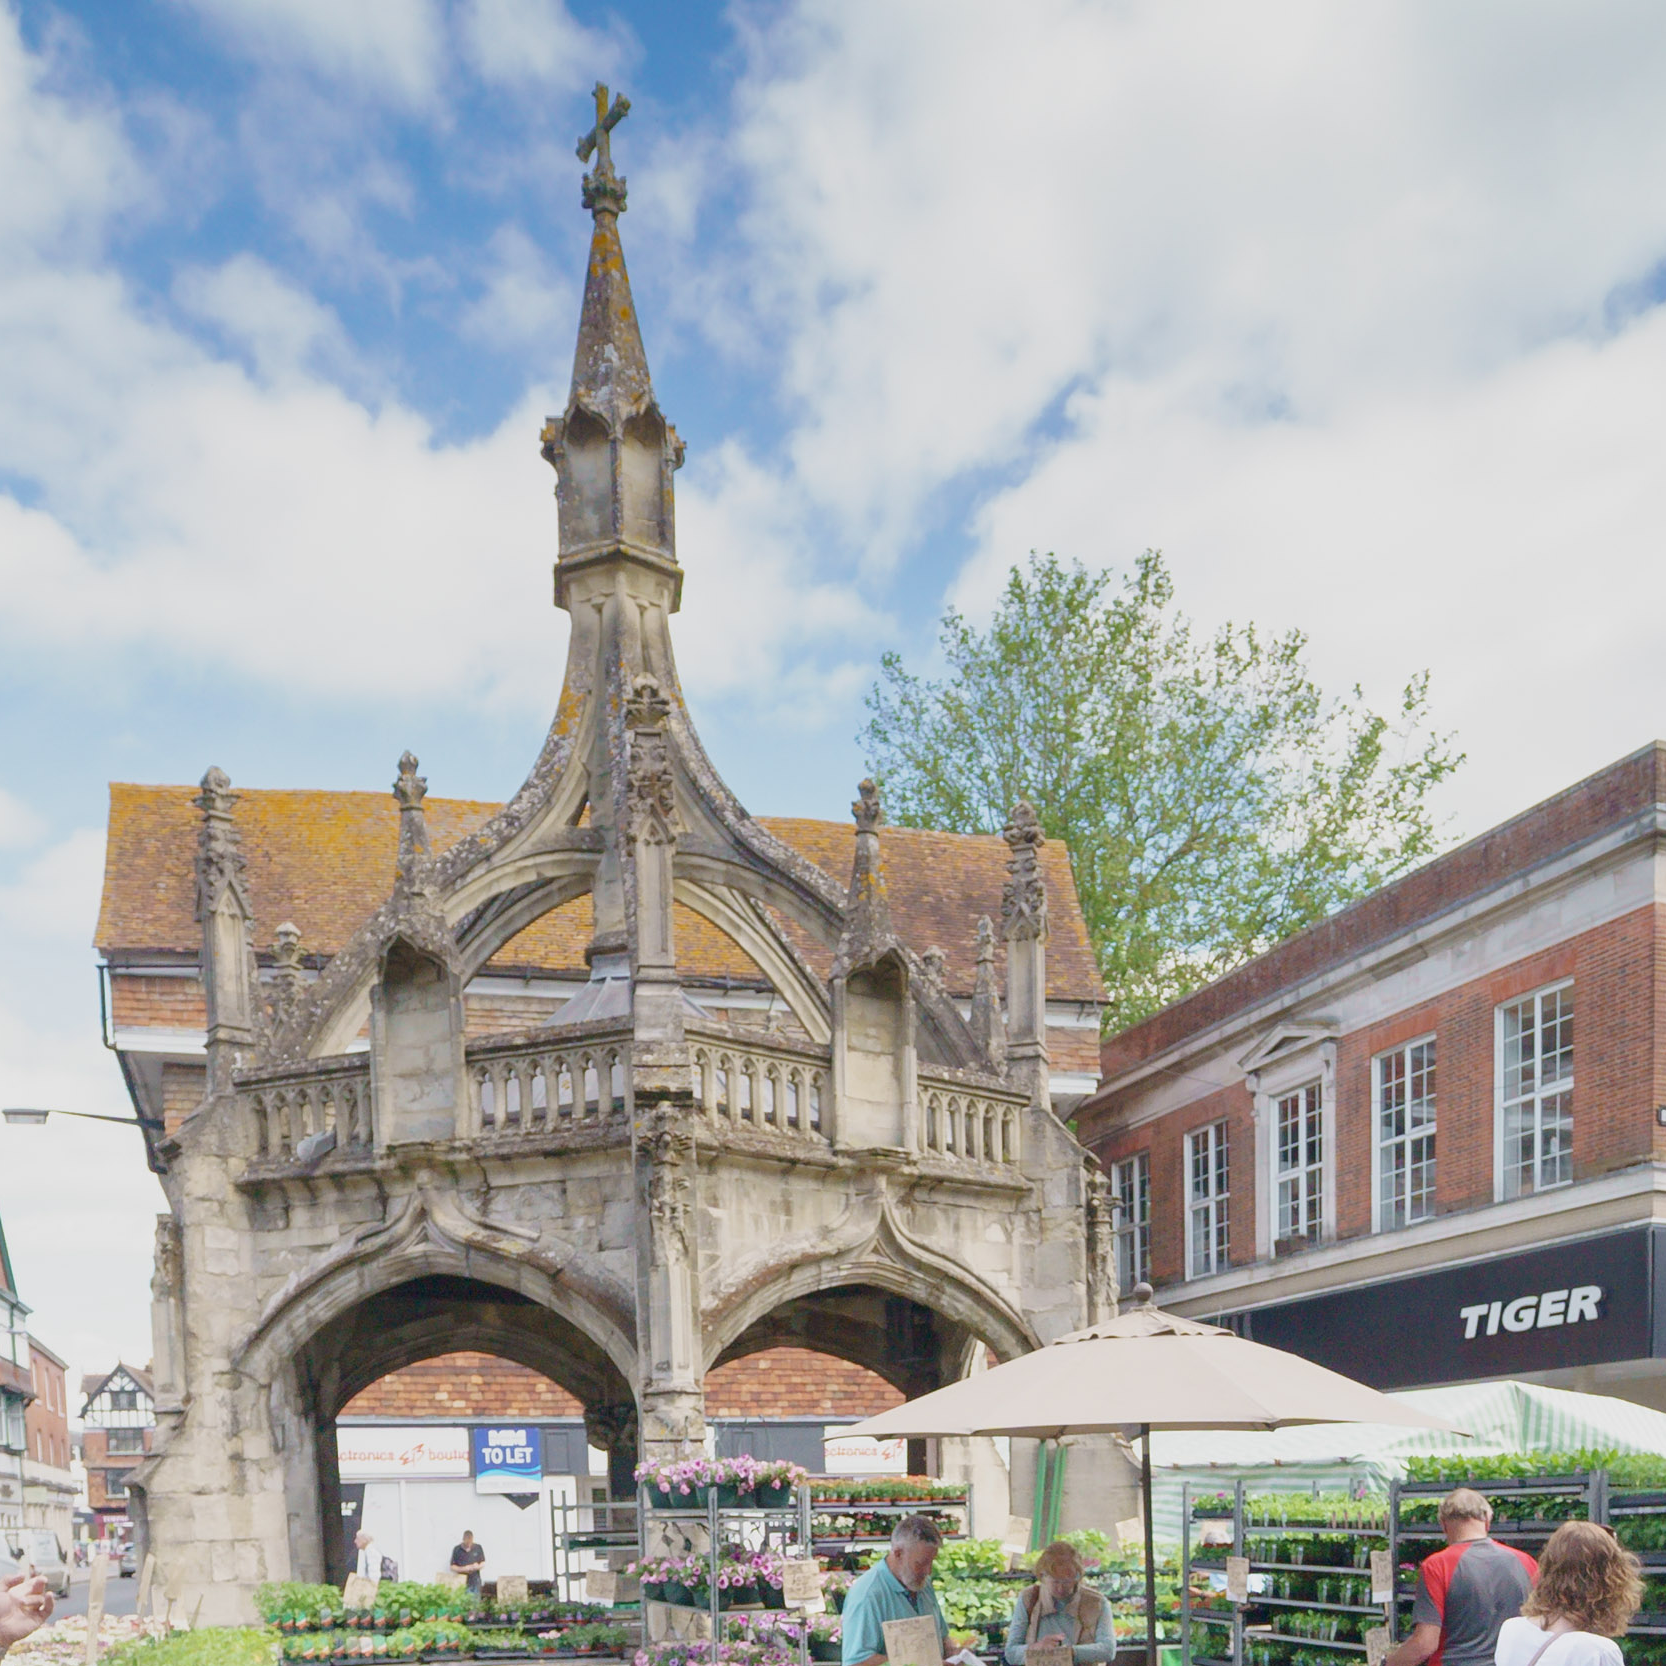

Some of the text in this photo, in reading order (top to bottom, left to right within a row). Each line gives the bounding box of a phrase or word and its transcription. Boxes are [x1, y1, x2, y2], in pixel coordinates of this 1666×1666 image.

[1460, 1285, 1602, 1339] TIGER
[482, 1447, 533, 1465] TO LET
